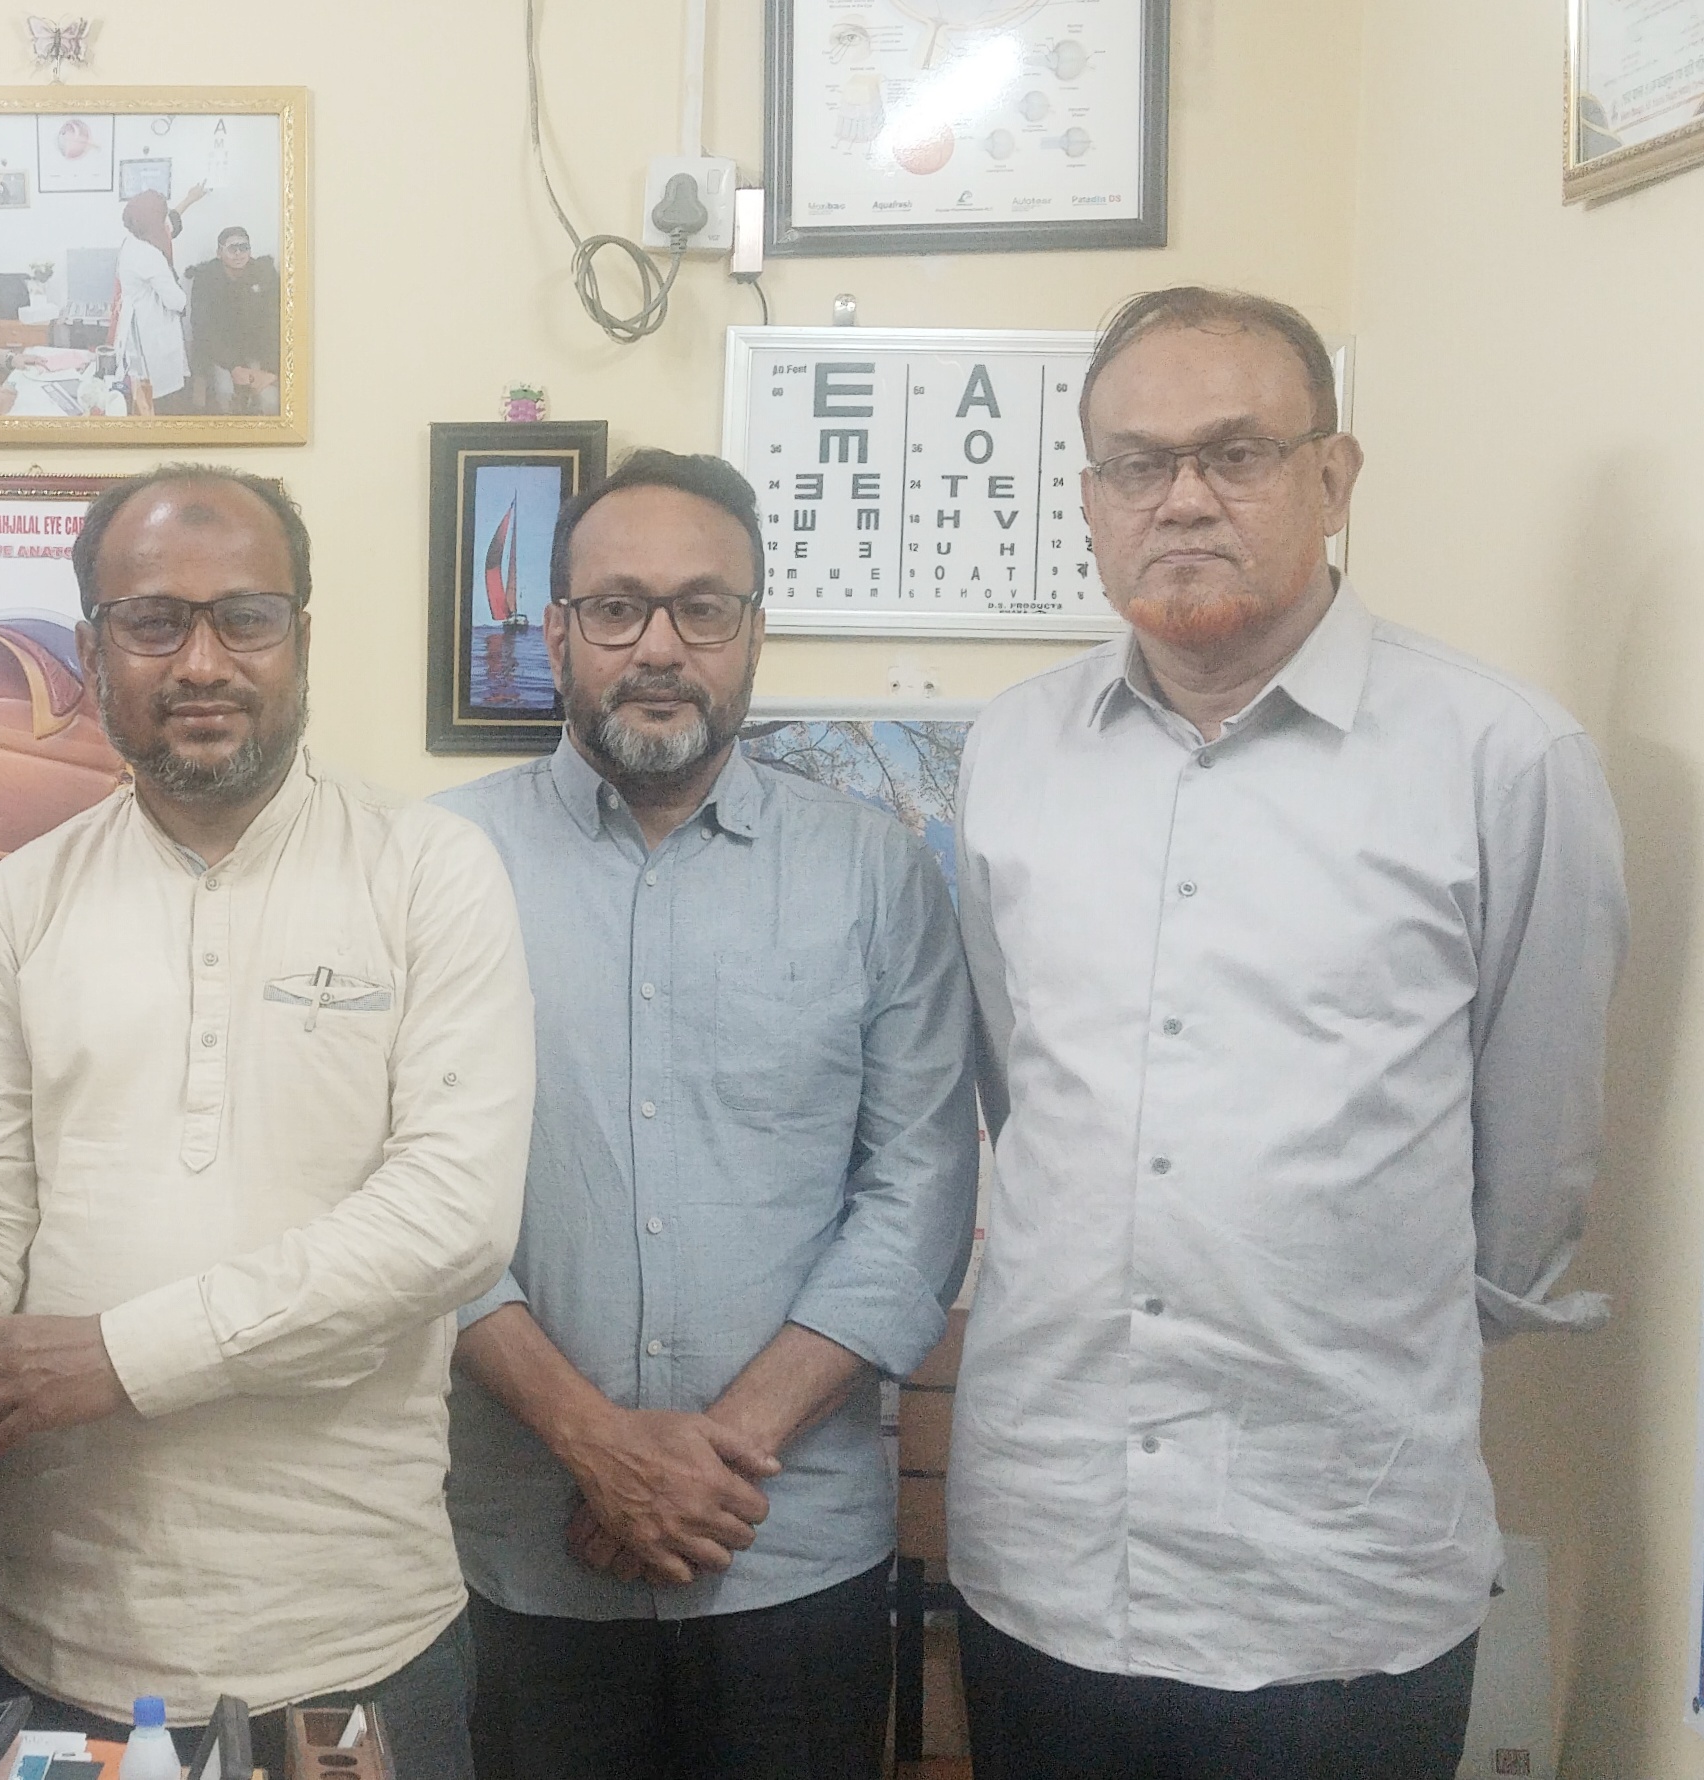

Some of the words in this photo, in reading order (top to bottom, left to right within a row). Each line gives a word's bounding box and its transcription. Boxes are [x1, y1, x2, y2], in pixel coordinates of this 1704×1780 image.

[1108, 194, 1122, 203] DS
[813, 362, 876, 418] E
[955, 363, 1001, 419] A
[1056, 383, 1068, 393] 60
[911, 444, 923, 454] 36
[1054, 441, 1066, 451] 36
[768, 480, 780, 490] 24
[851, 473, 881, 500] E
[909, 480, 922, 490] 24
[941, 474, 969, 498] T
[987, 475, 1016, 499] E
[1053, 478, 1064, 488] 24
[936, 509, 960, 529] H
[993, 510, 1020, 529] V
[1052, 510, 1063, 520] 18
[44, 516, 62, 535] EYE
[767, 541, 778, 551] 12
[908, 543, 919, 552] 12
[936, 542, 952, 556] U
[999, 543, 1015, 556] H
[1051, 540, 1062, 549] 12
[970, 566, 981, 581] A
[1006, 566, 1016, 581] T
[1052, 566, 1059, 576] 9
[935, 588, 942, 598] E
[1010, 589, 1018, 598] V
[1051, 590, 1058, 600] 6
